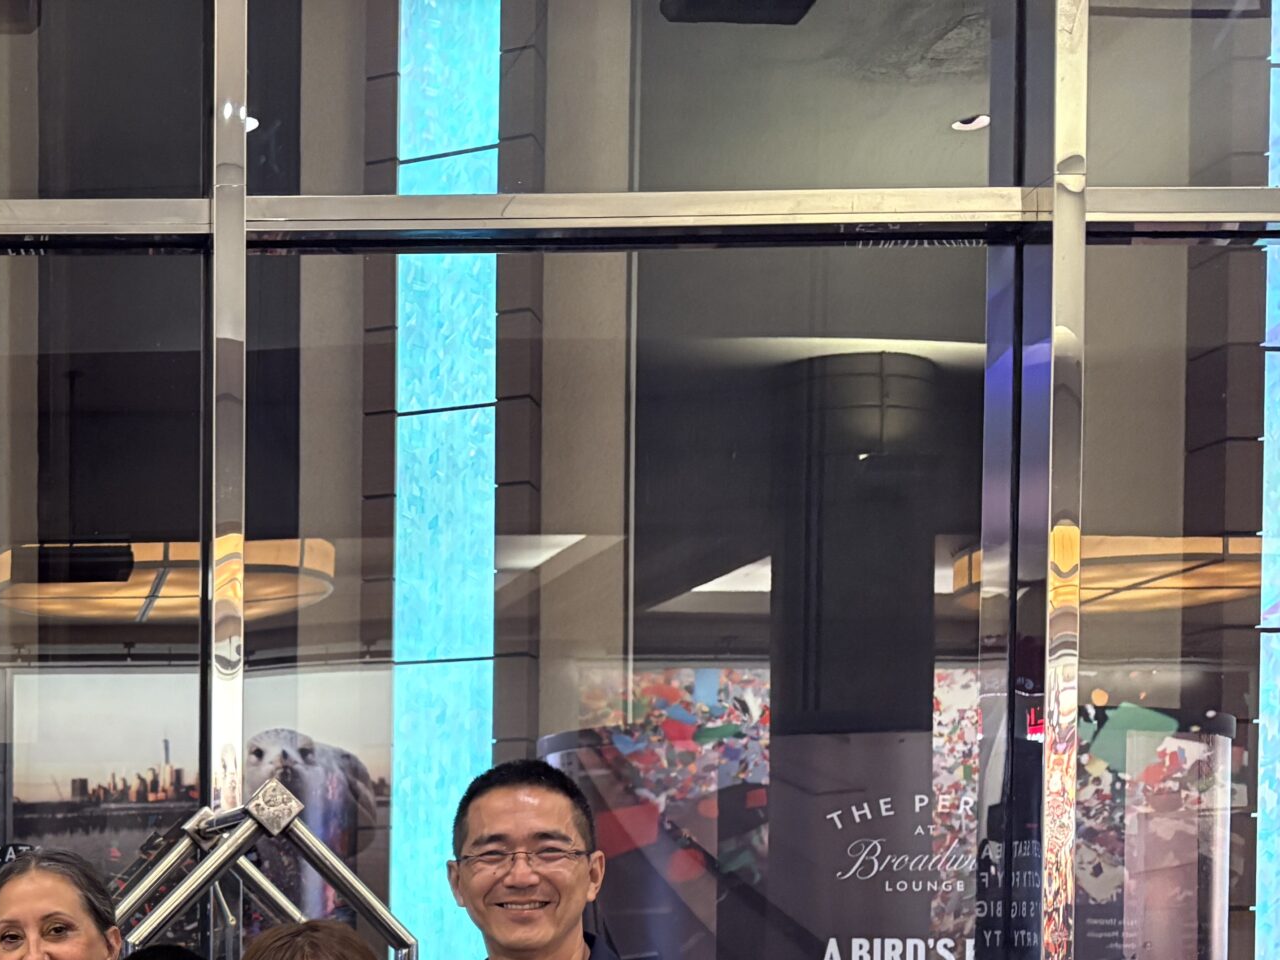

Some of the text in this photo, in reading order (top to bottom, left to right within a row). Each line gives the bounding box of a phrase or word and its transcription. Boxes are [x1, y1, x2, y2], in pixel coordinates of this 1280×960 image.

[826, 794, 977, 830] THE PER
[913, 824, 936, 836] AT
[884, 879, 966, 892] LOUNGE
